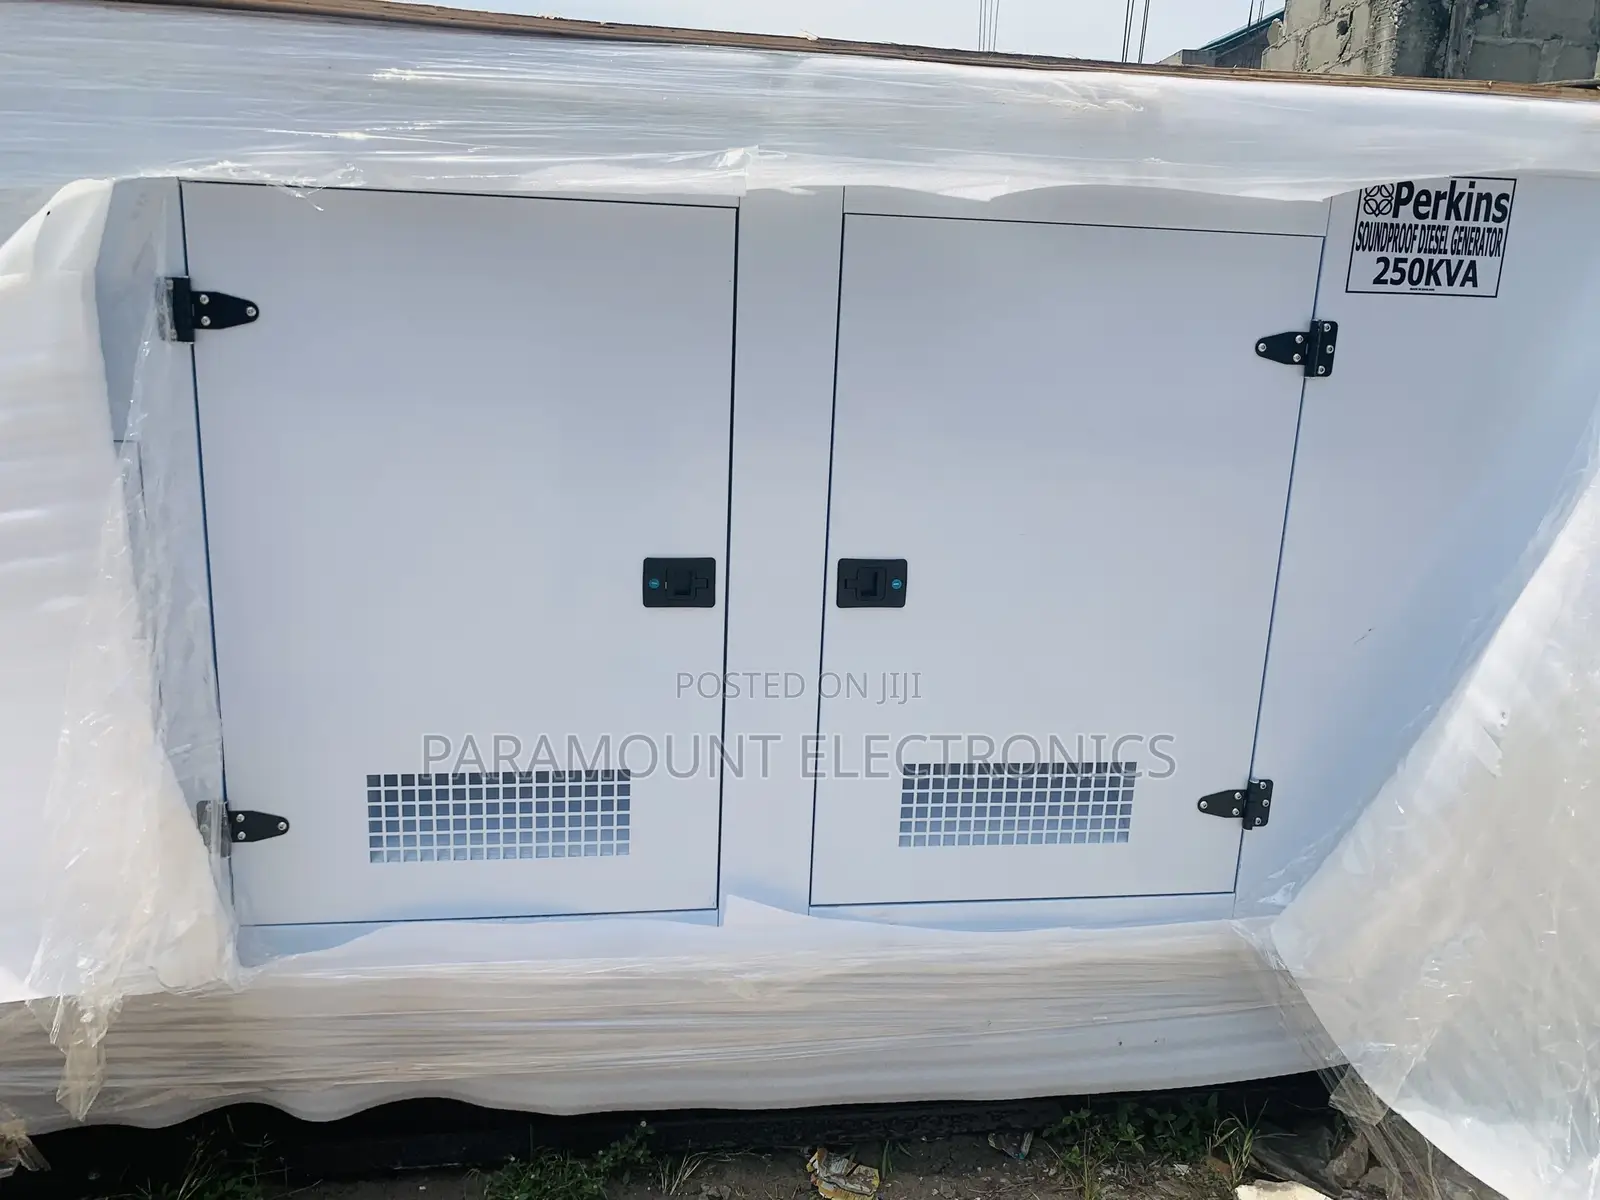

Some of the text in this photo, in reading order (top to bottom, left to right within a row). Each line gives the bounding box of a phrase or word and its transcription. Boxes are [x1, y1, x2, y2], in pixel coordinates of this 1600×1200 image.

[1392, 180, 1510, 223] Perkins
[1355, 221, 1504, 257] SOUNDPROOF DIESEL GENERATOR
[1372, 256, 1478, 288] 250KVA
